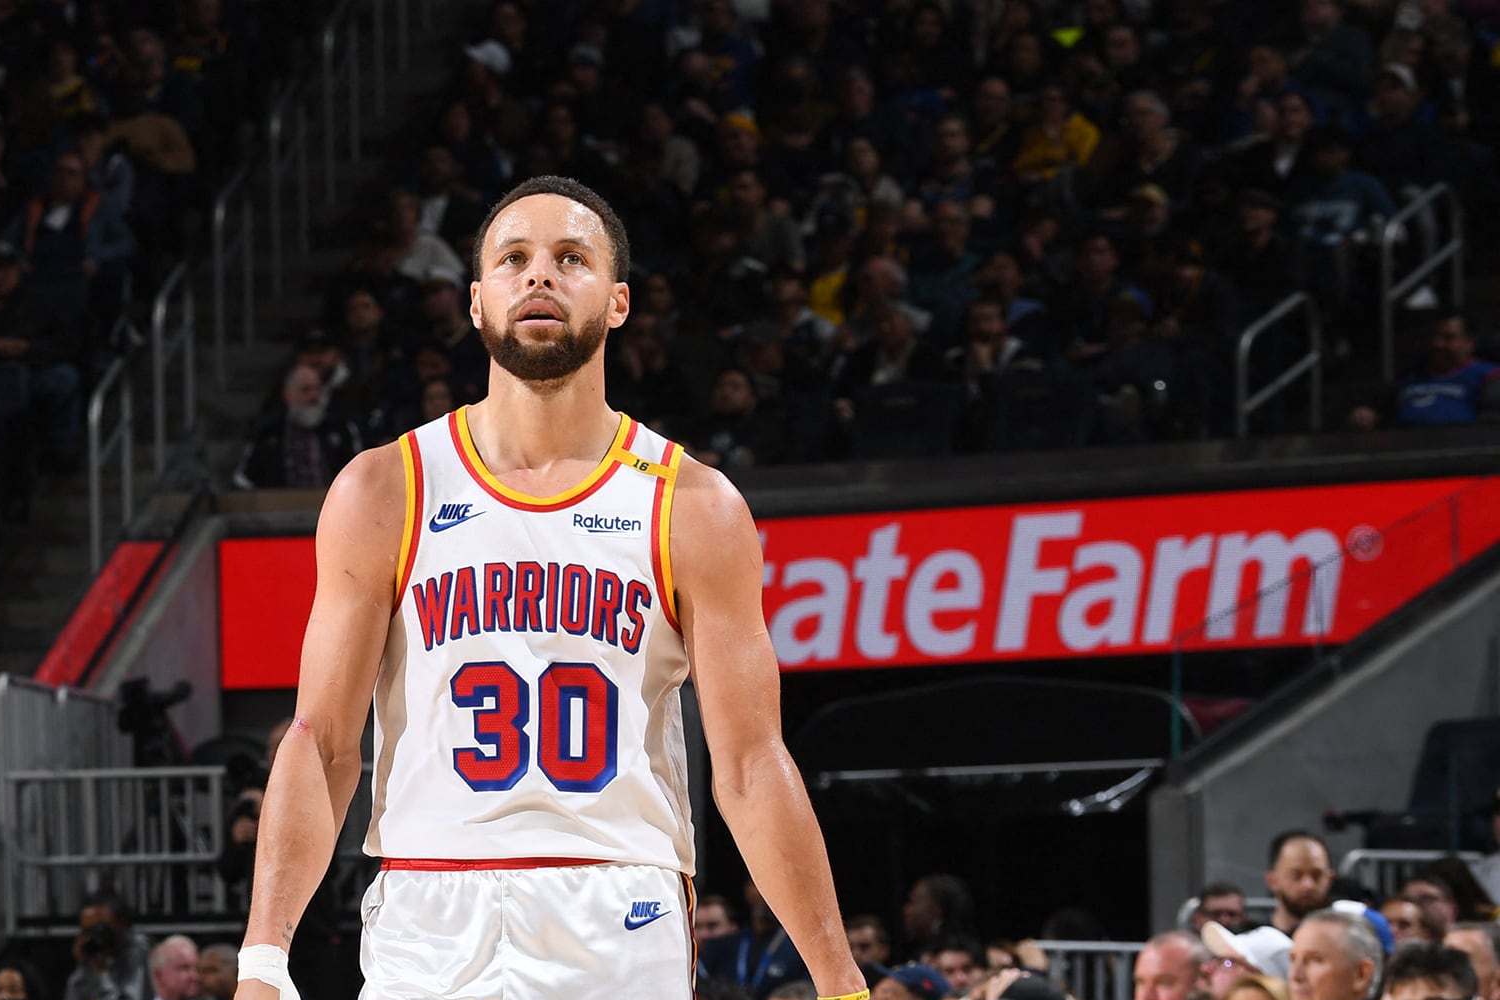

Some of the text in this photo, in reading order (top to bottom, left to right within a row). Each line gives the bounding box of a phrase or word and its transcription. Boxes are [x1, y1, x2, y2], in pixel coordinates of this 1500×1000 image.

[633, 459, 650, 472] 16
[437, 503, 473, 520] NIKE
[573, 513, 642, 532] Rakuten
[759, 510, 1344, 666] ate Farm
[411, 561, 652, 655] WARRIORS
[449, 661, 619, 793] 30
[630, 901, 661, 918] NIKE
